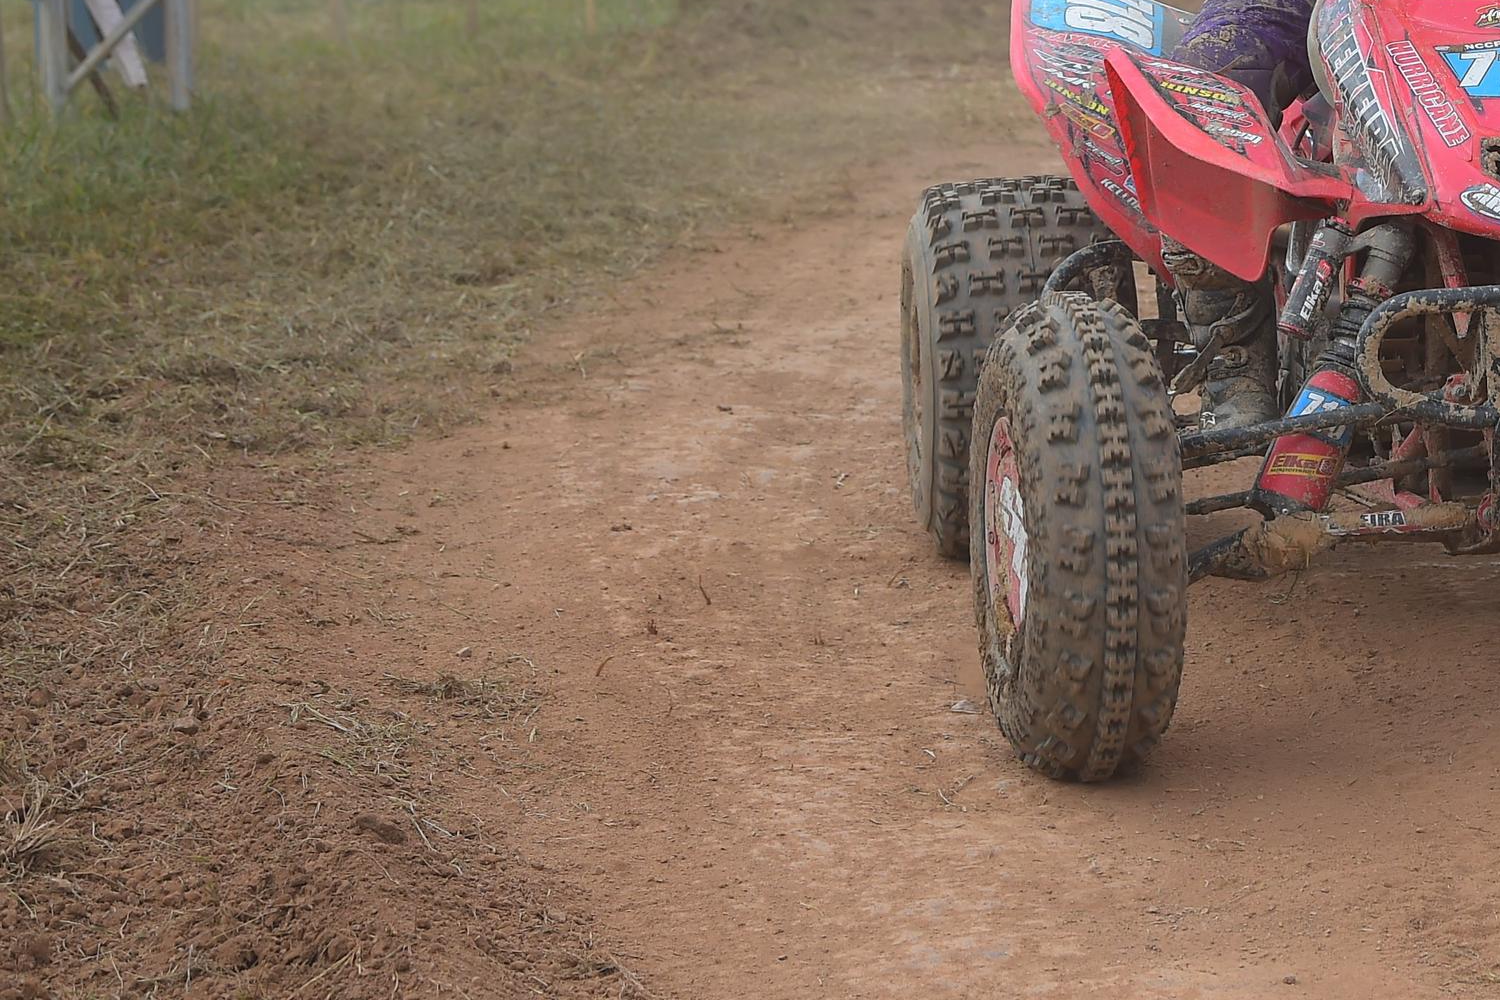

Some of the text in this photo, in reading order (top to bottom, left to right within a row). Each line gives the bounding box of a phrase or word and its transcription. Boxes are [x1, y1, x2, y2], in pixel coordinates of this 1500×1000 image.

[1160, 80, 1242, 106] HINSO
[1386, 40, 1472, 147] HURRICANE
[1300, 280, 1323, 320] Elka
